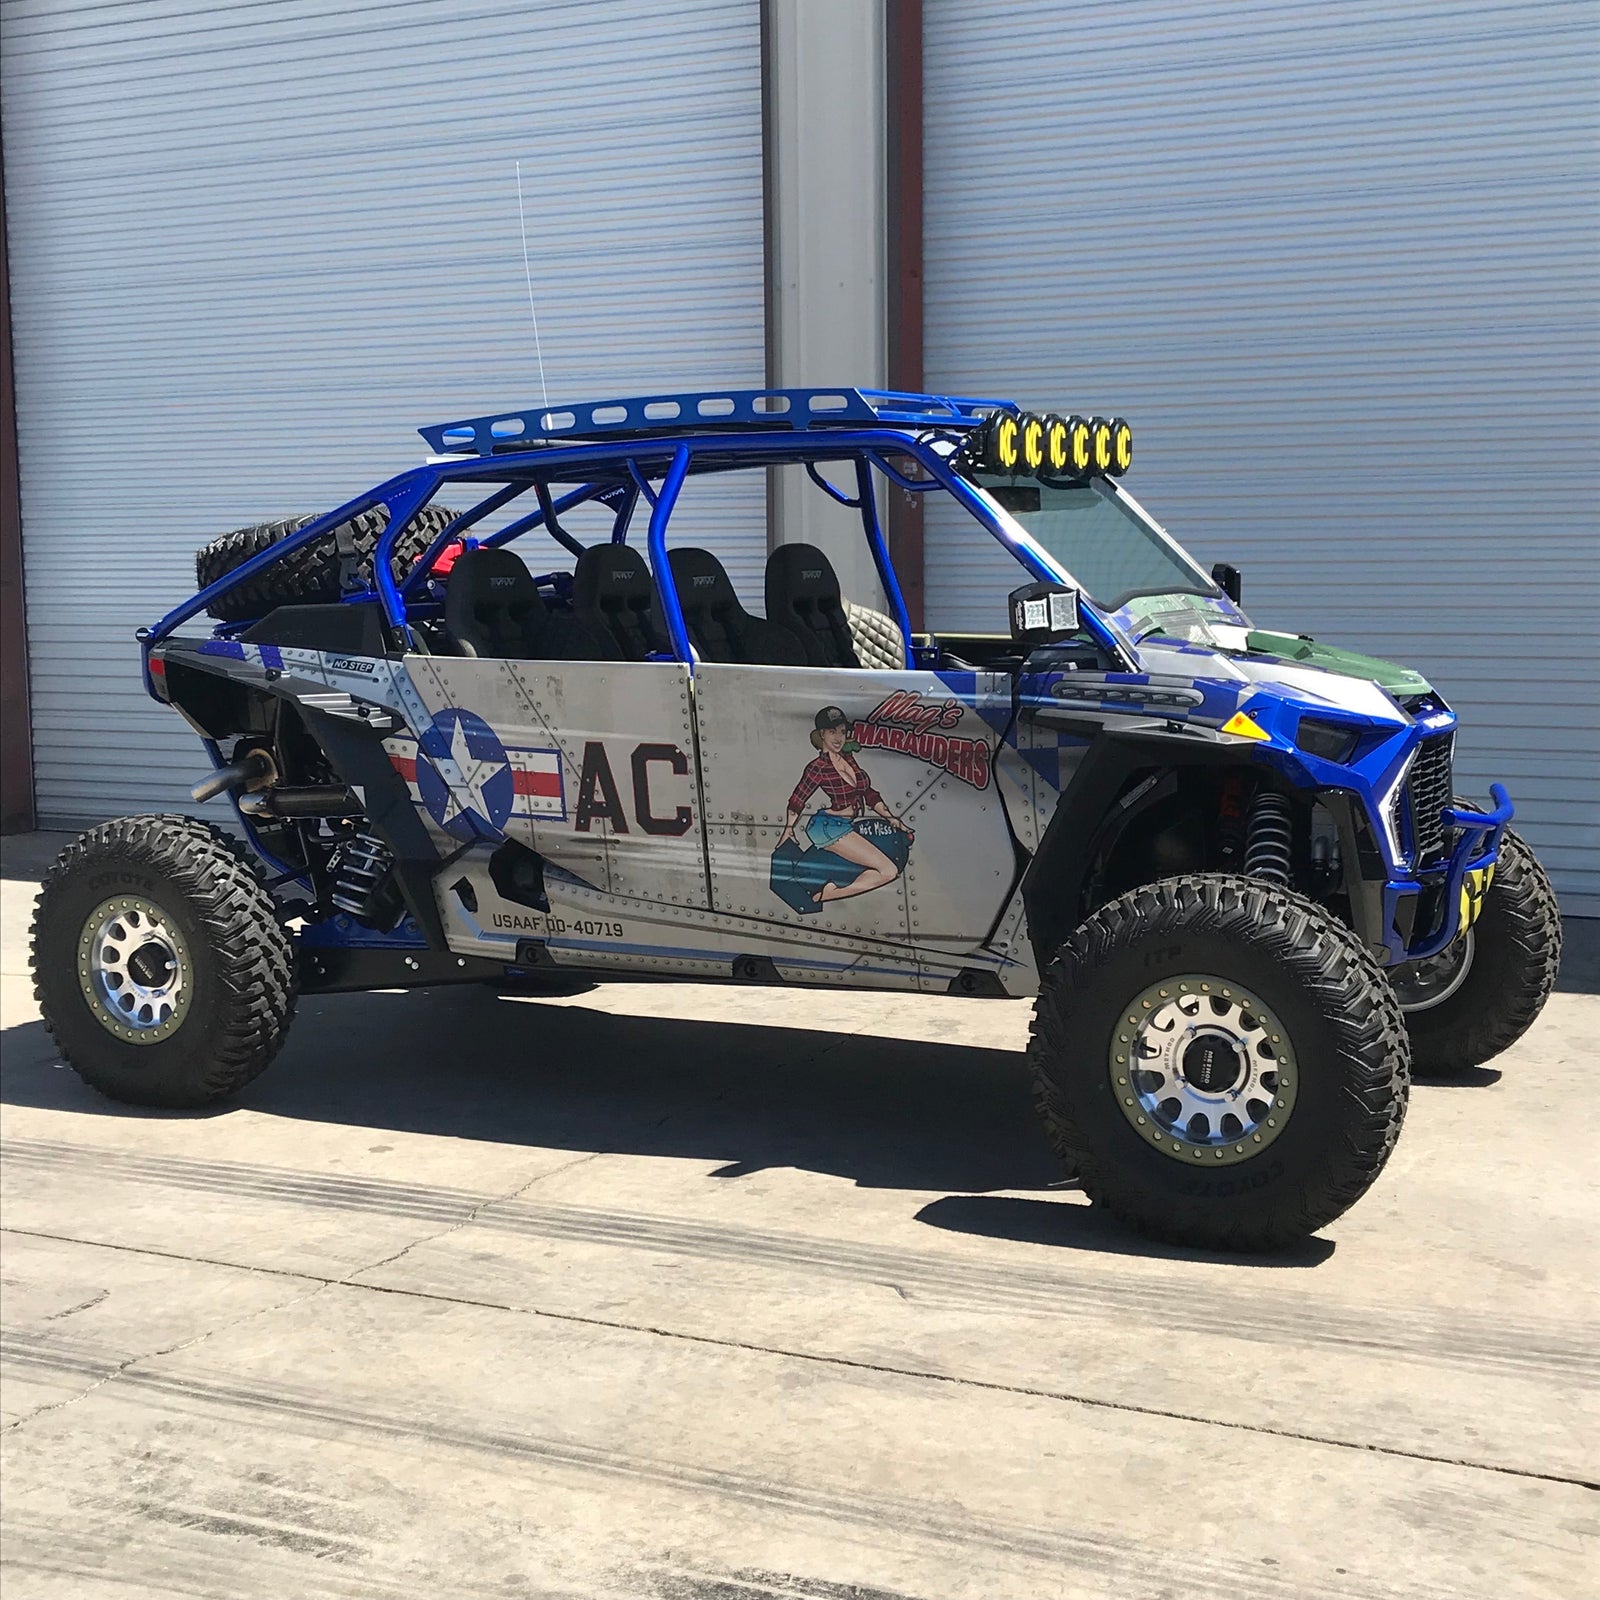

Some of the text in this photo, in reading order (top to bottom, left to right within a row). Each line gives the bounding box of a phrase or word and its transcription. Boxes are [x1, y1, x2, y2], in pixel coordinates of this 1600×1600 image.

[334, 660, 373, 672] NO STEP
[868, 690, 963, 735] Mag's
[853, 721, 989, 789] MARAUDERS
[575, 741, 693, 836] AC
[493, 913, 541, 930] USAAF
[1164, 1037, 1175, 1070] METHOD
[1204, 1050, 1214, 1084] METHOD
